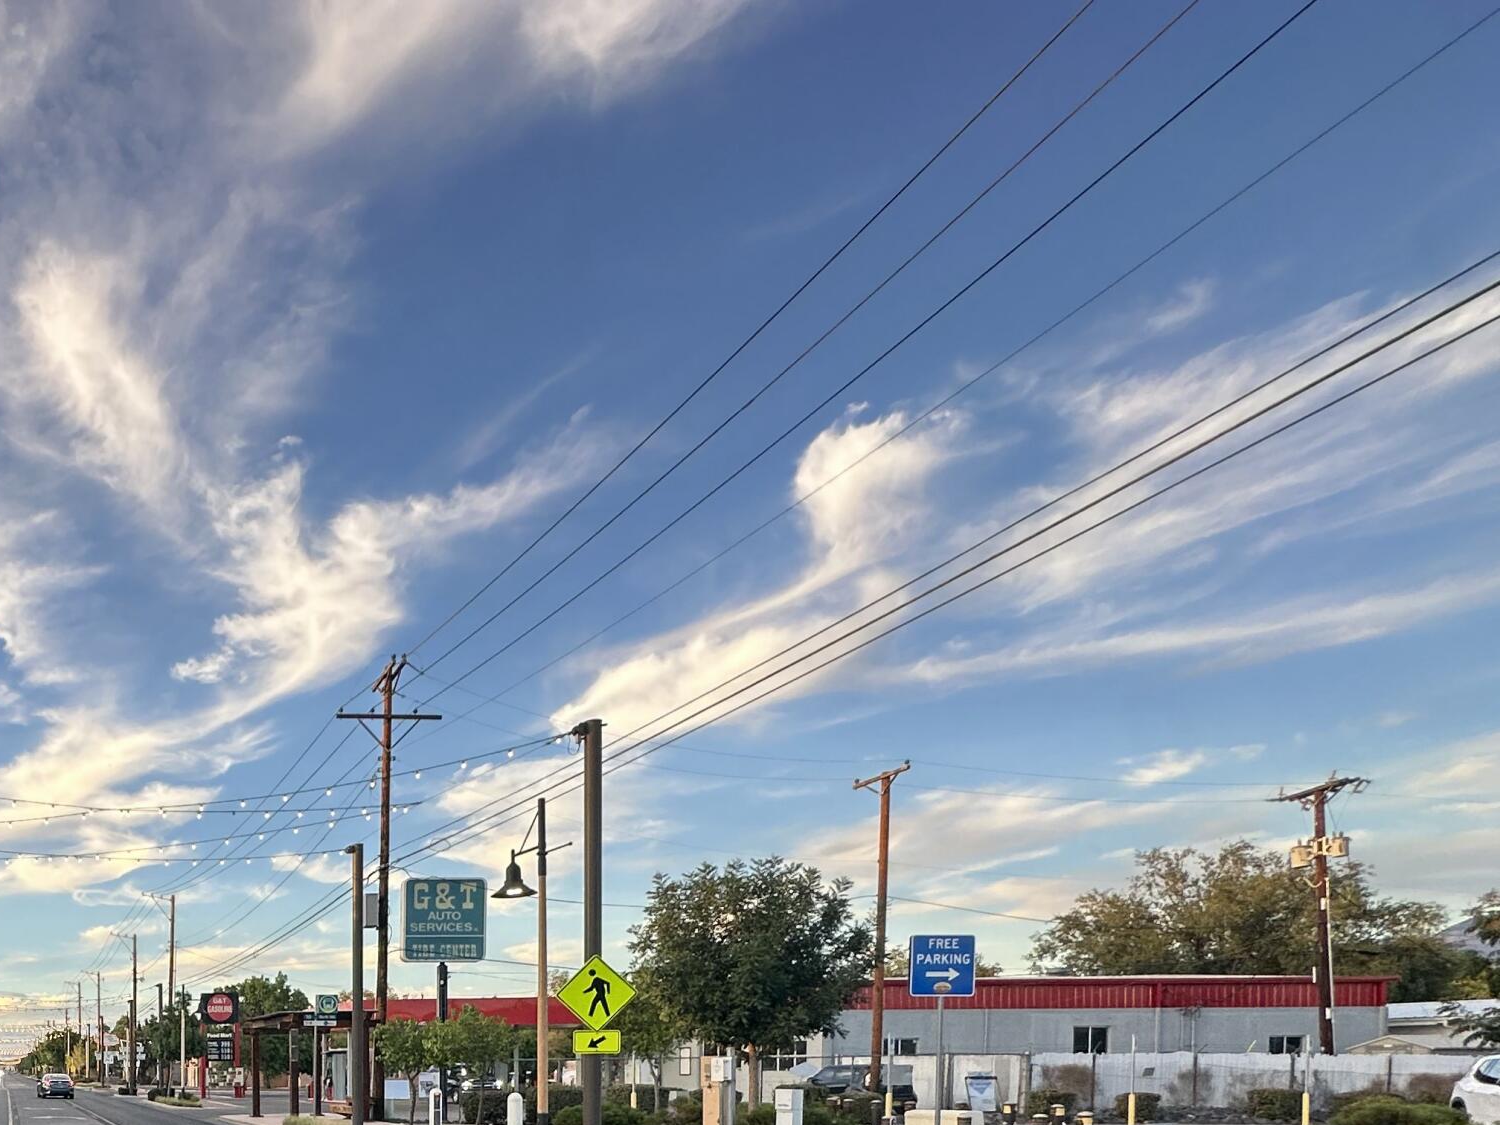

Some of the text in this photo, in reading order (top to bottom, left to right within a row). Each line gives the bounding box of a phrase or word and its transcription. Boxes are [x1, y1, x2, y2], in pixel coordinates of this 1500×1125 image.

[414, 882, 477, 909] G&T
[428, 911, 462, 921] AUTO
[928, 938, 960, 949] FREE
[440, 944, 477, 957] CENTER
[916, 953, 971, 965] PARKING
